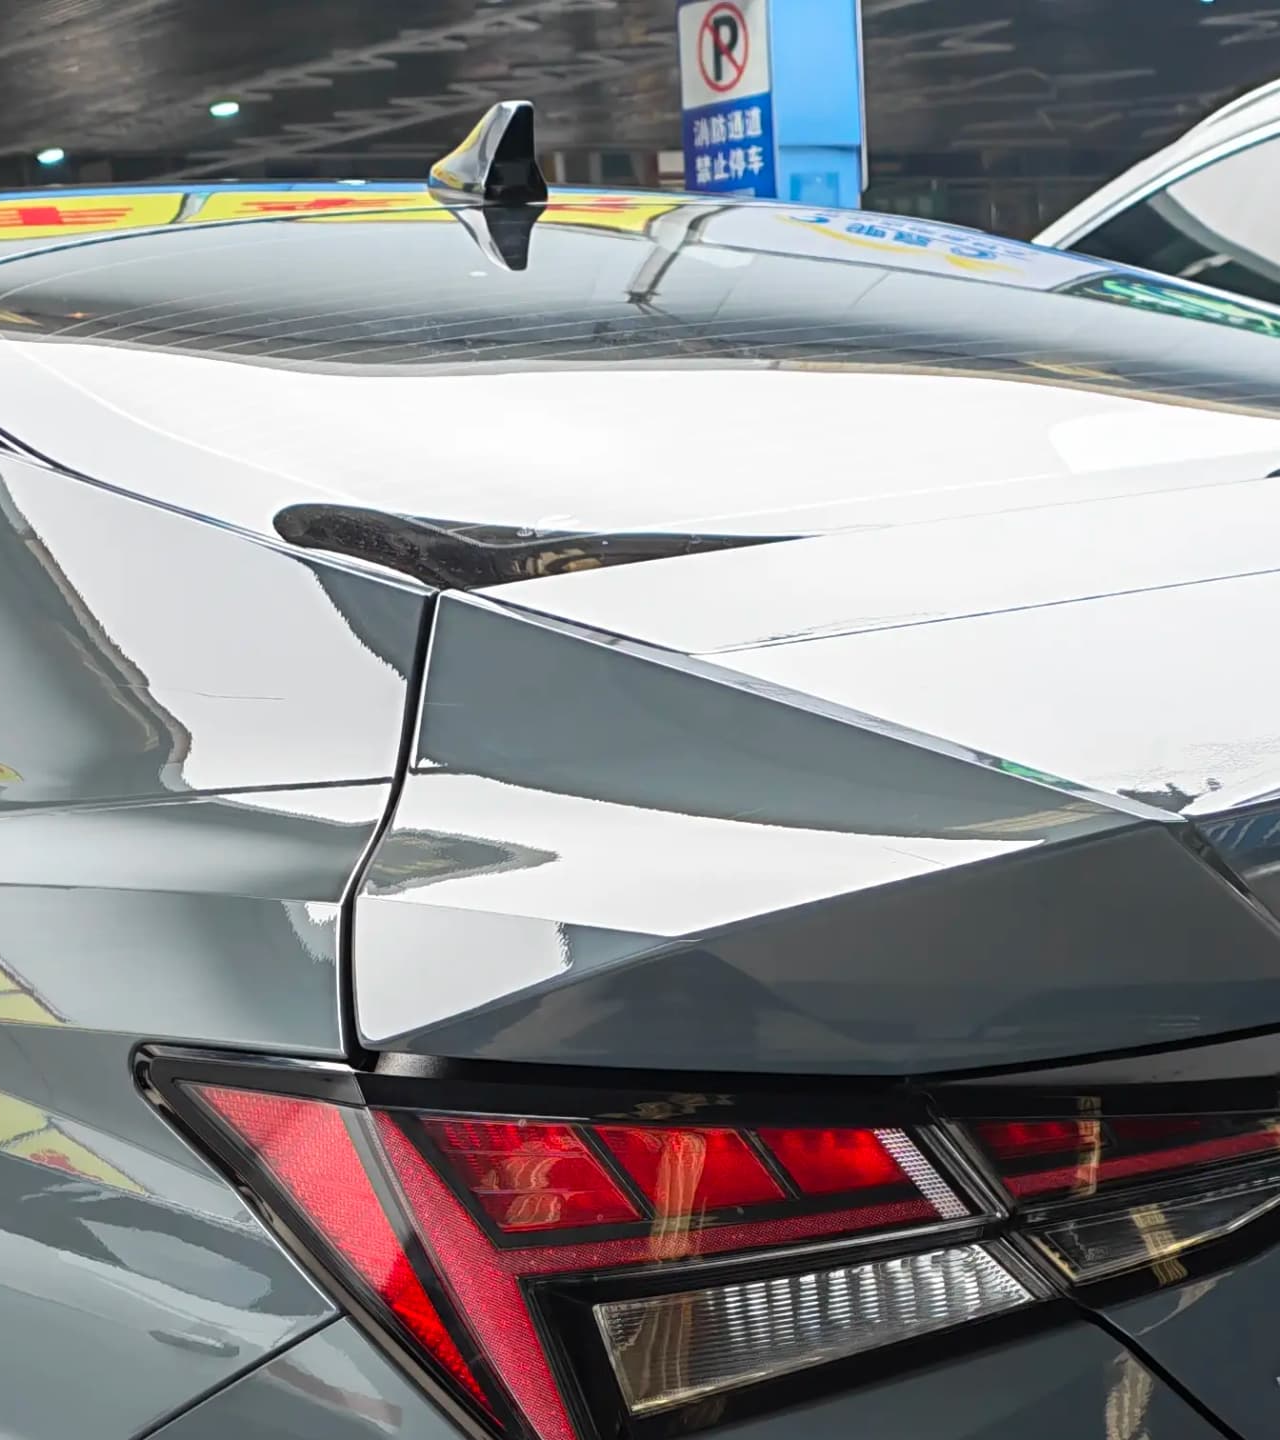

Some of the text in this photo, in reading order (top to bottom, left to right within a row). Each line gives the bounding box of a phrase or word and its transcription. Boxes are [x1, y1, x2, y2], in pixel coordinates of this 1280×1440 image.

[693, 106, 762, 147] 消防通道
[695, 145, 764, 184] 禁止停车
